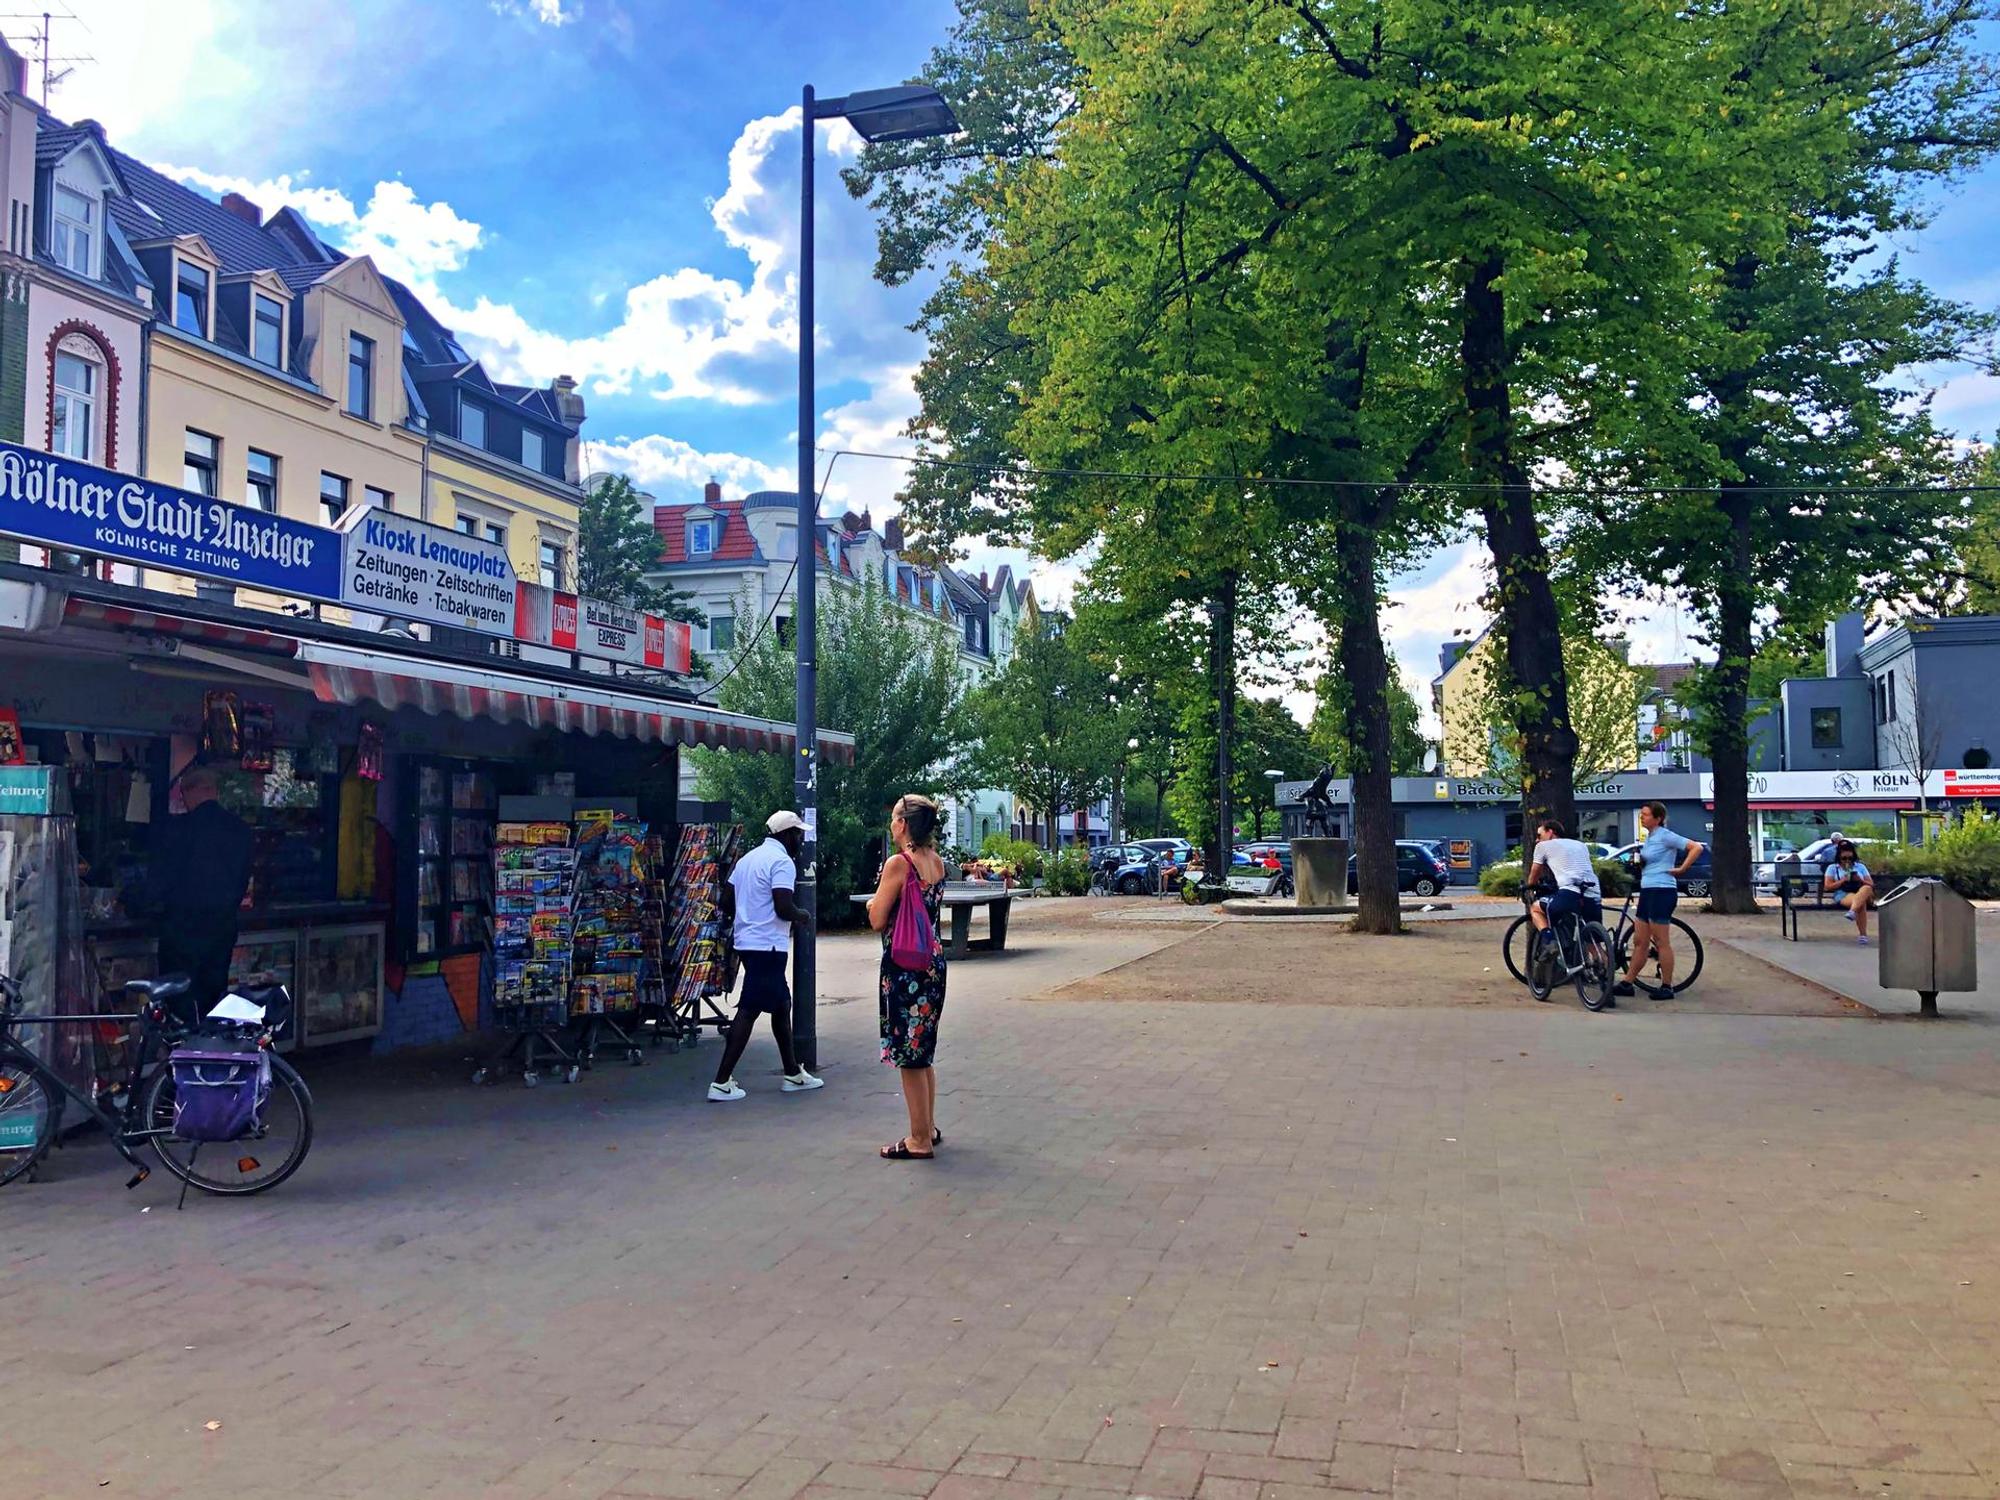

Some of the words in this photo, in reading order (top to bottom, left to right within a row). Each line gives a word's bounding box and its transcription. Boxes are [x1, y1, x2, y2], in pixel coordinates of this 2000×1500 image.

[0, 450, 114, 520] Kölner
[116, 482, 315, 568] Stadt-Anzeiger
[96, 527, 178, 557] KÖLNISCHE
[185, 547, 241, 571] ZEITUNG
[366, 518, 415, 555] Kiosk
[420, 533, 507, 579] Lenauplatz
[353, 573, 418, 605] Getränke
[434, 592, 506, 624] Tabakwaren
[355, 549, 428, 584] Zeitungen
[436, 569, 514, 604] Zeitschriften
[598, 628, 627, 648] EXPRESS
[1872, 771, 1909, 786] KÖLN
